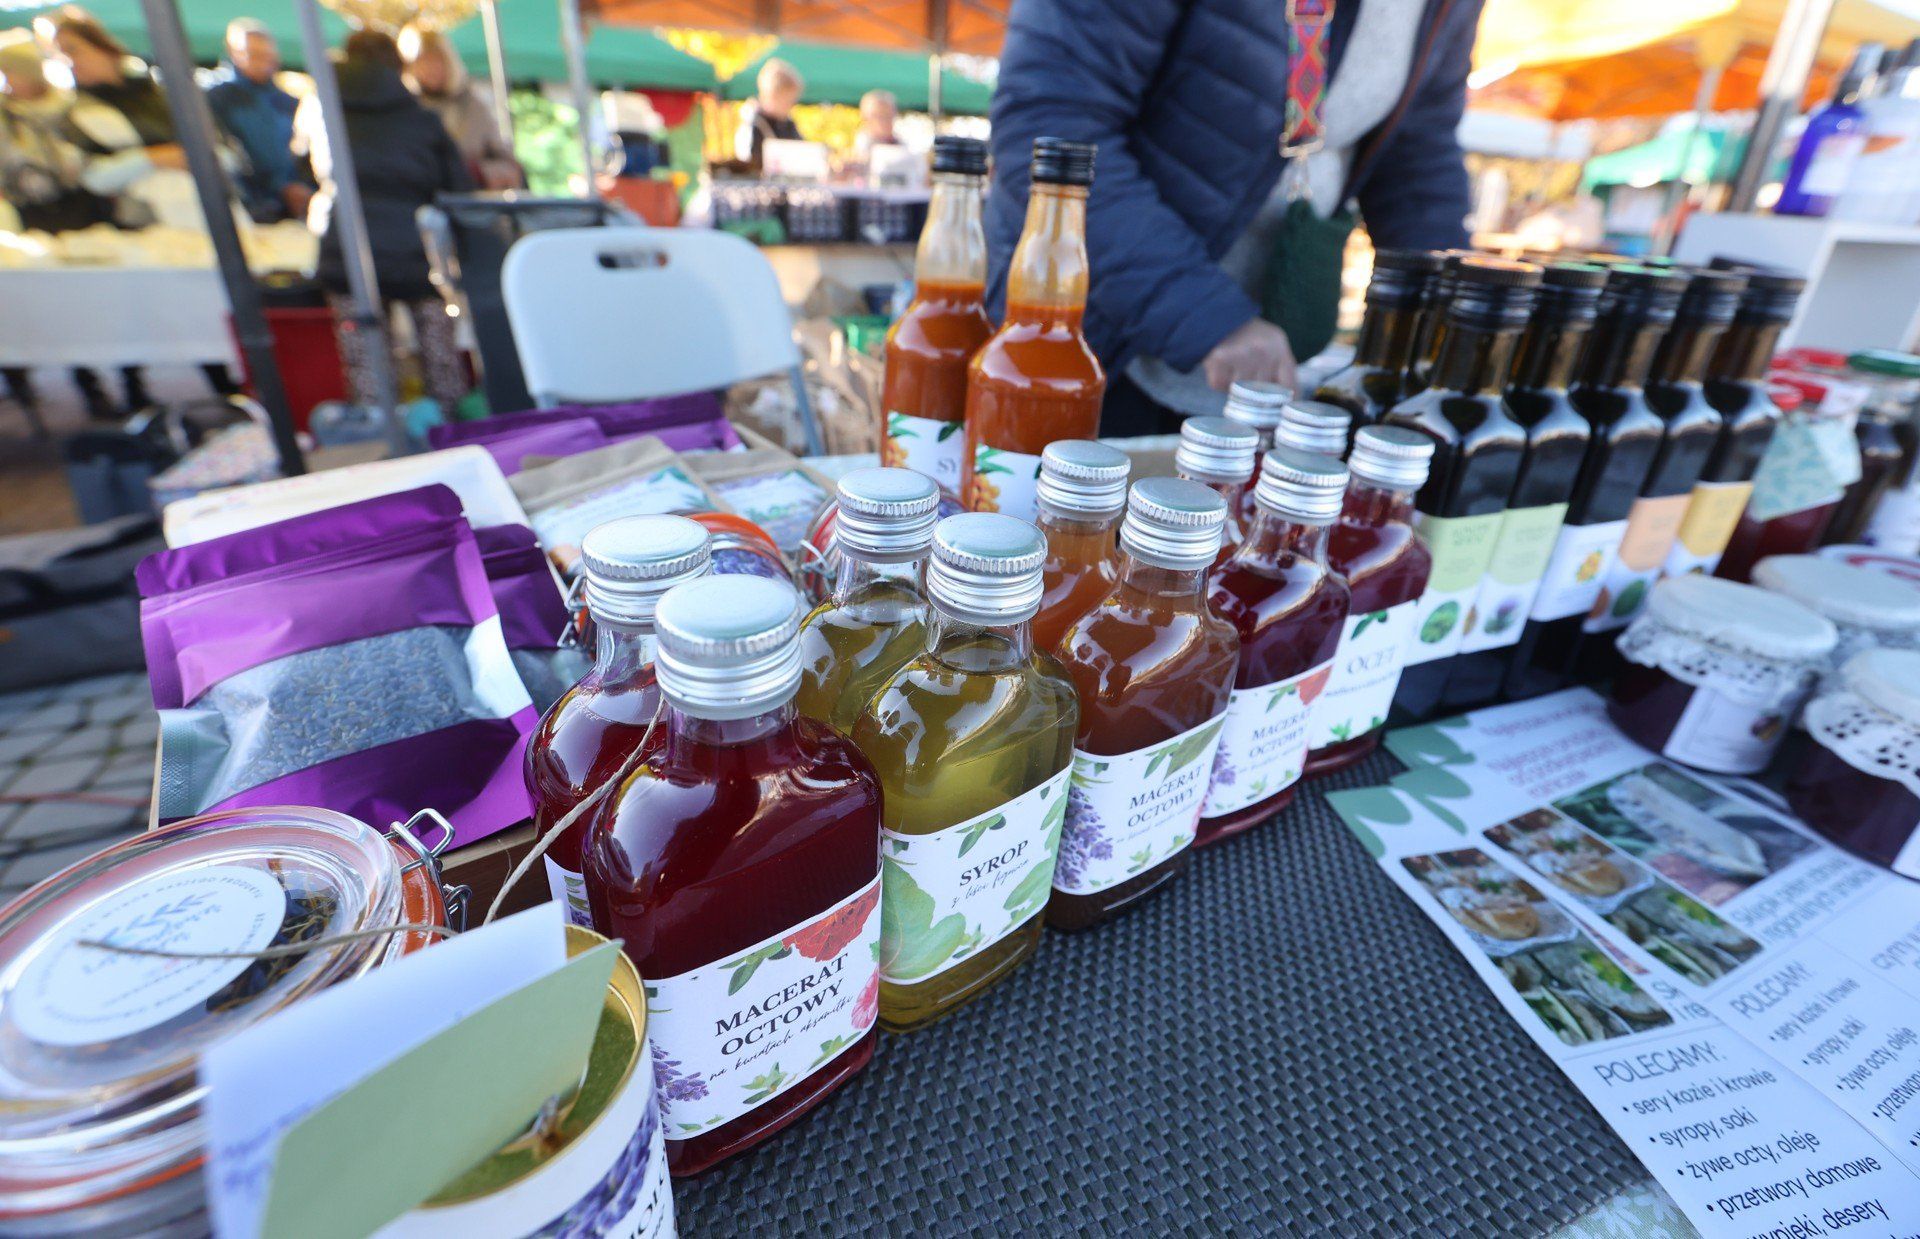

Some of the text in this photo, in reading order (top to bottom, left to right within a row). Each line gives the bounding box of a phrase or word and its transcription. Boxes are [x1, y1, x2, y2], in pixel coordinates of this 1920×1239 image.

[1250, 727, 1304, 757] OCTOWY
[1128, 786, 1197, 827] OCTOWY
[1129, 764, 1203, 809] MACERAT
[960, 840, 1028, 886] SYROP
[715, 953, 848, 1037] MACERAT
[721, 978, 843, 1055] OCTOWY
[710, 1069, 727, 1081] na
[735, 1030, 793, 1070] kwiatach
[1887, 1026, 1918, 1051] oleje
[1594, 1040, 1728, 1086] POLECAMY:
[1633, 1094, 1674, 1115] sery
[1668, 1082, 1716, 1106] kozie
[1718, 1067, 1778, 1093] krowie
[1877, 1061, 1920, 1121] przetwor
[1659, 1106, 1759, 1149] syropy, soki
[1686, 1129, 1821, 1182] żywe octy, oleje
[1716, 1153, 1882, 1220] przetwory domowe
[1822, 1198, 1890, 1231] desery
